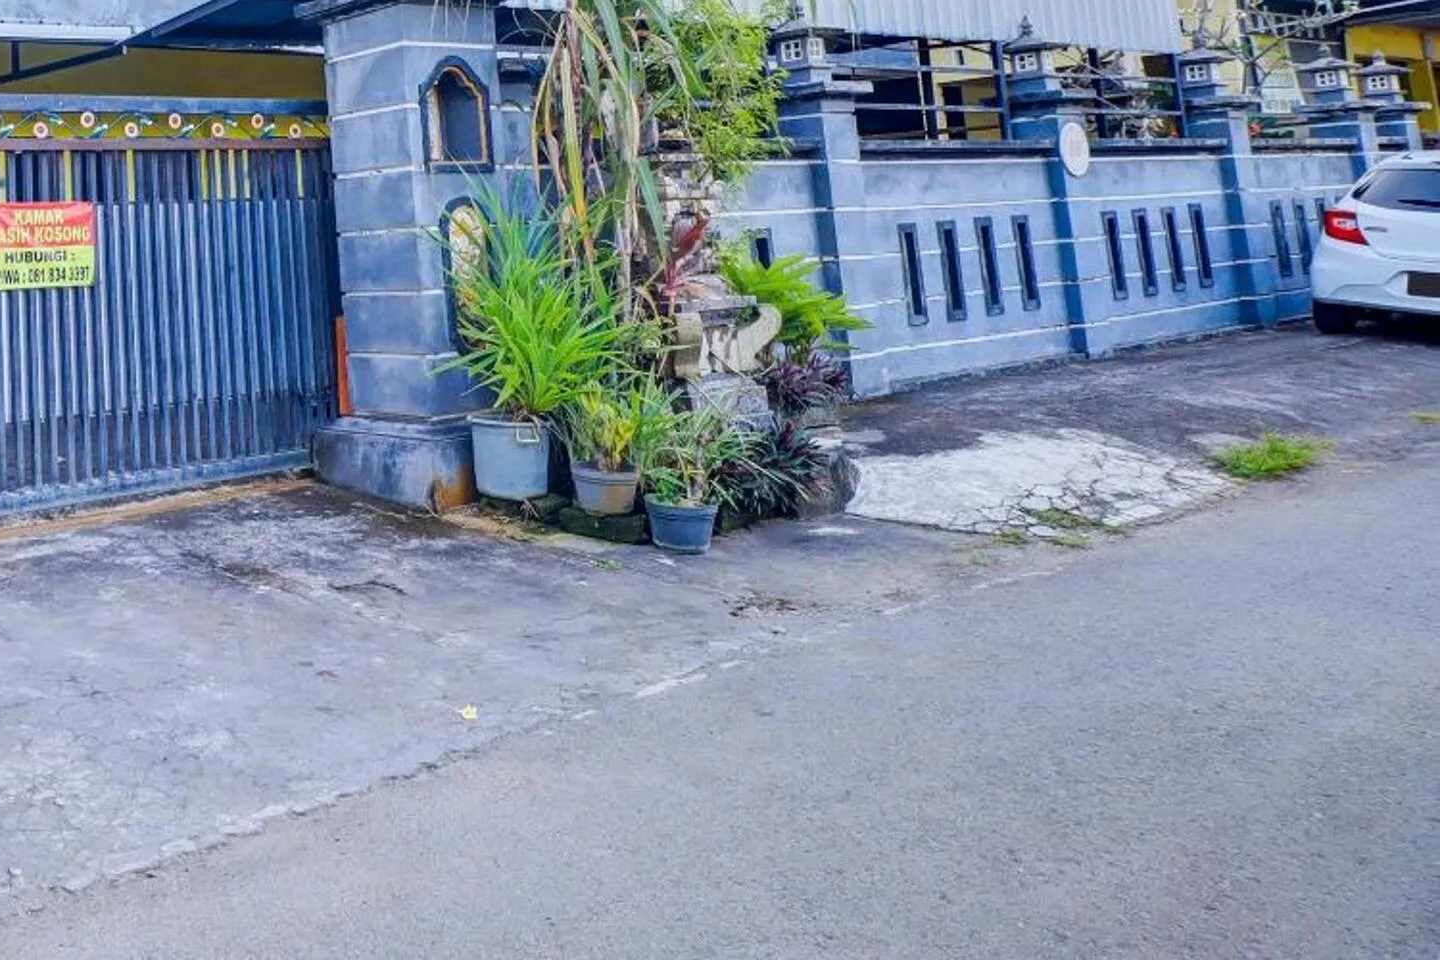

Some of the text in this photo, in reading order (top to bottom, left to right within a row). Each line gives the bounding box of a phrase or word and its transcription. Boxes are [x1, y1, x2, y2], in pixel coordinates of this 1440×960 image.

[15, 208, 64, 225] KAMAR
[34, 226, 90, 243] KOSONG
[5, 251, 67, 264] HUBUNGI
